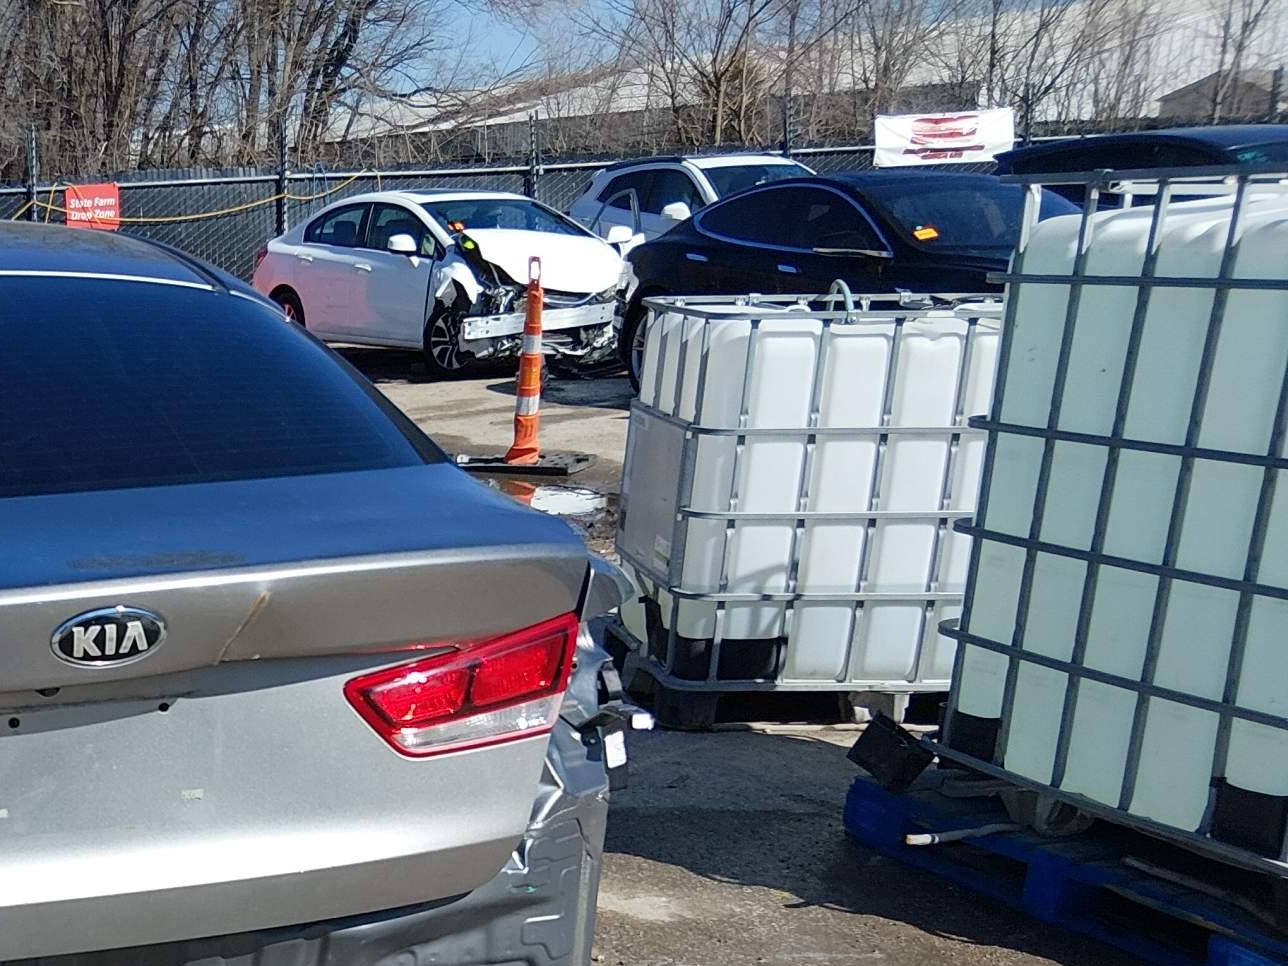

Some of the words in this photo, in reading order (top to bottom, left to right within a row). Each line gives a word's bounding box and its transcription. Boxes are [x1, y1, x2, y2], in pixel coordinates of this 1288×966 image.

[70, 198, 92, 209] State
[94, 196, 115, 207] Farm
[72, 211, 92, 221] Drop
[94, 209, 115, 219] Zone
[72, 620, 148, 658] KIA
